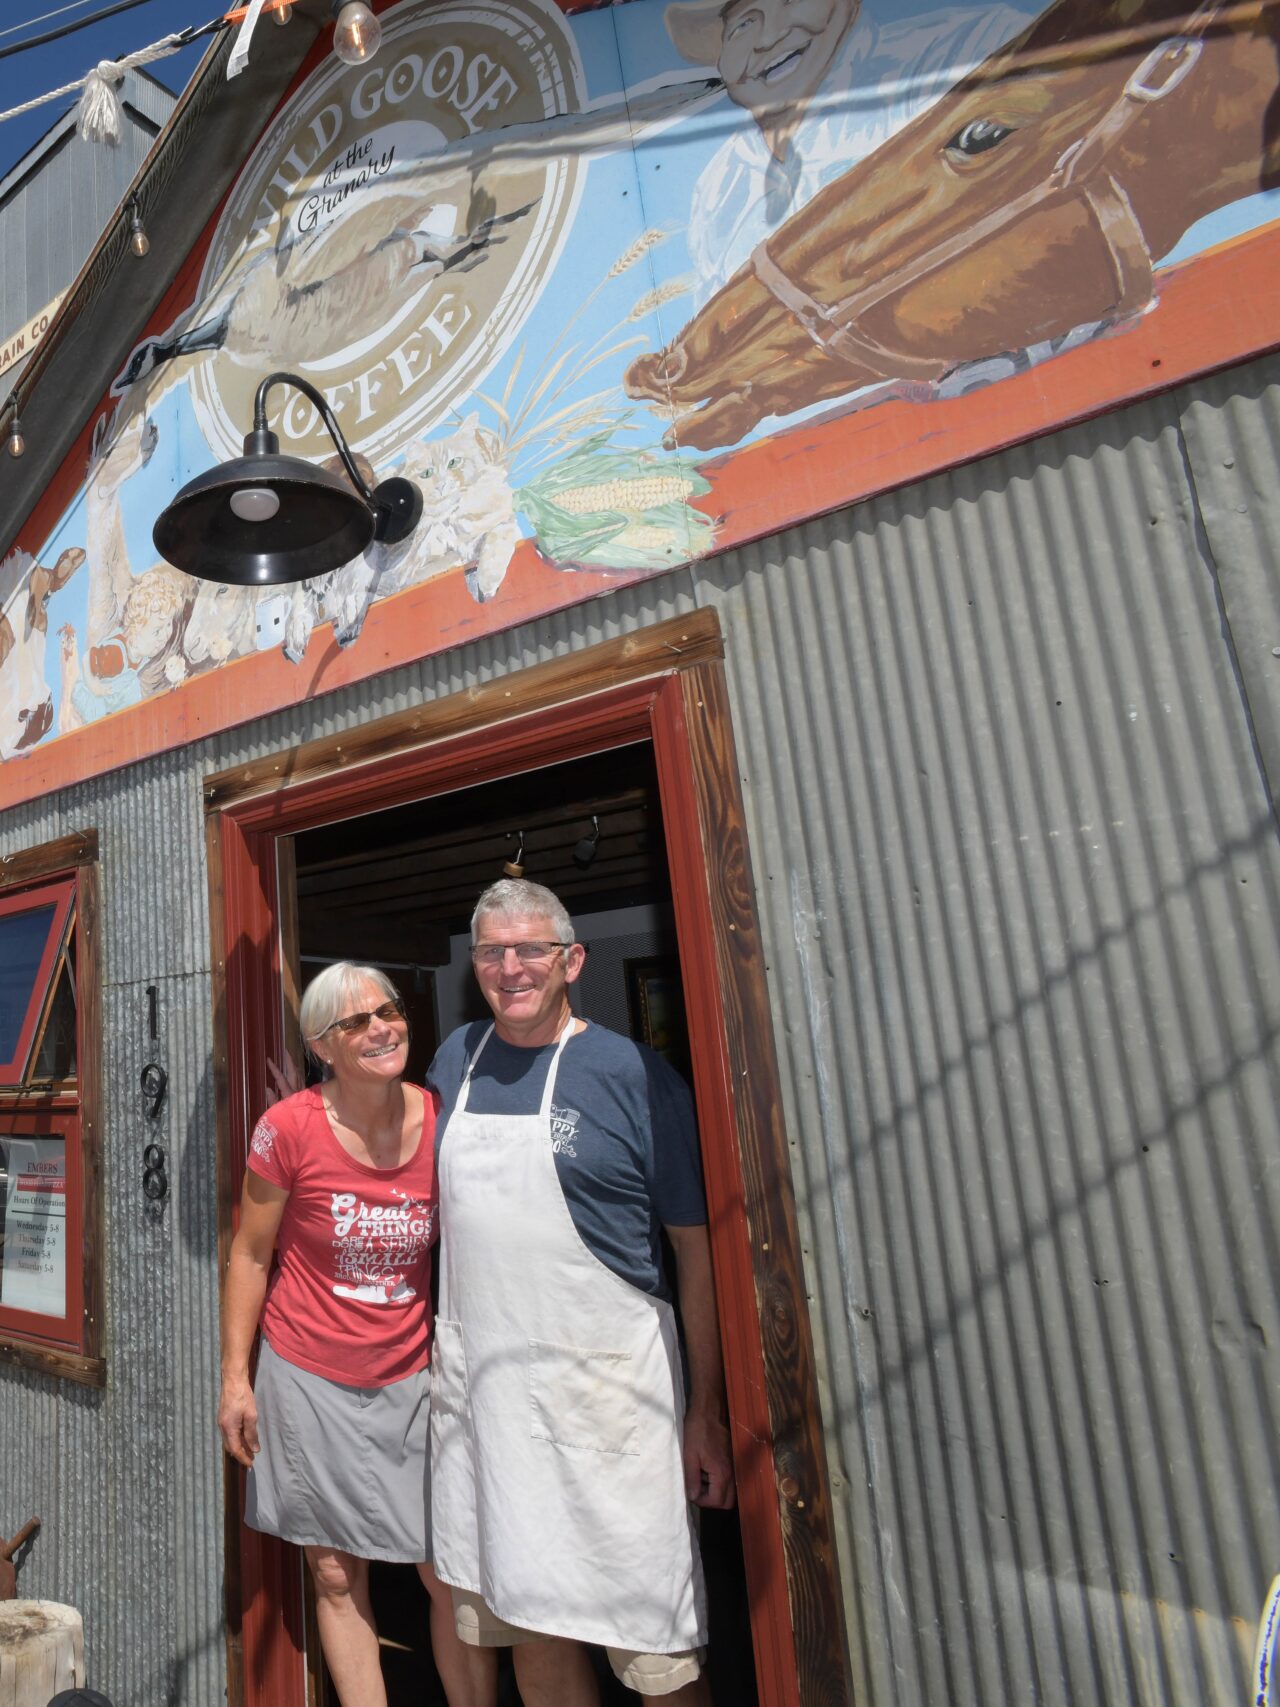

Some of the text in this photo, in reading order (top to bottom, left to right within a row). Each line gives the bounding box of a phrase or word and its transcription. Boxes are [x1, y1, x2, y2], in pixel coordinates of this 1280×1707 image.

[239, 46, 519, 256] WILD GOOSE
[323, 137, 373, 189] at the
[297, 145, 395, 233] Granary
[31, 315, 49, 340] CO
[552, 1120, 580, 1138] PPY
[27, 1161, 58, 1175] EMBERS
[13, 1195, 29, 1205] Hours
[30, 1196, 39, 1205] Of
[331, 1193, 412, 1236] Great
[16, 1219, 60, 1233] Wednesday 5-8
[357, 1219, 432, 1237] THINGS
[46, 1237, 56, 1247] 5-8
[365, 1236, 430, 1253] A SERIES
[21, 1246, 40, 1259] Friday
[345, 1252, 418, 1265] SMALL
[331, 1261, 395, 1281] THINGS
